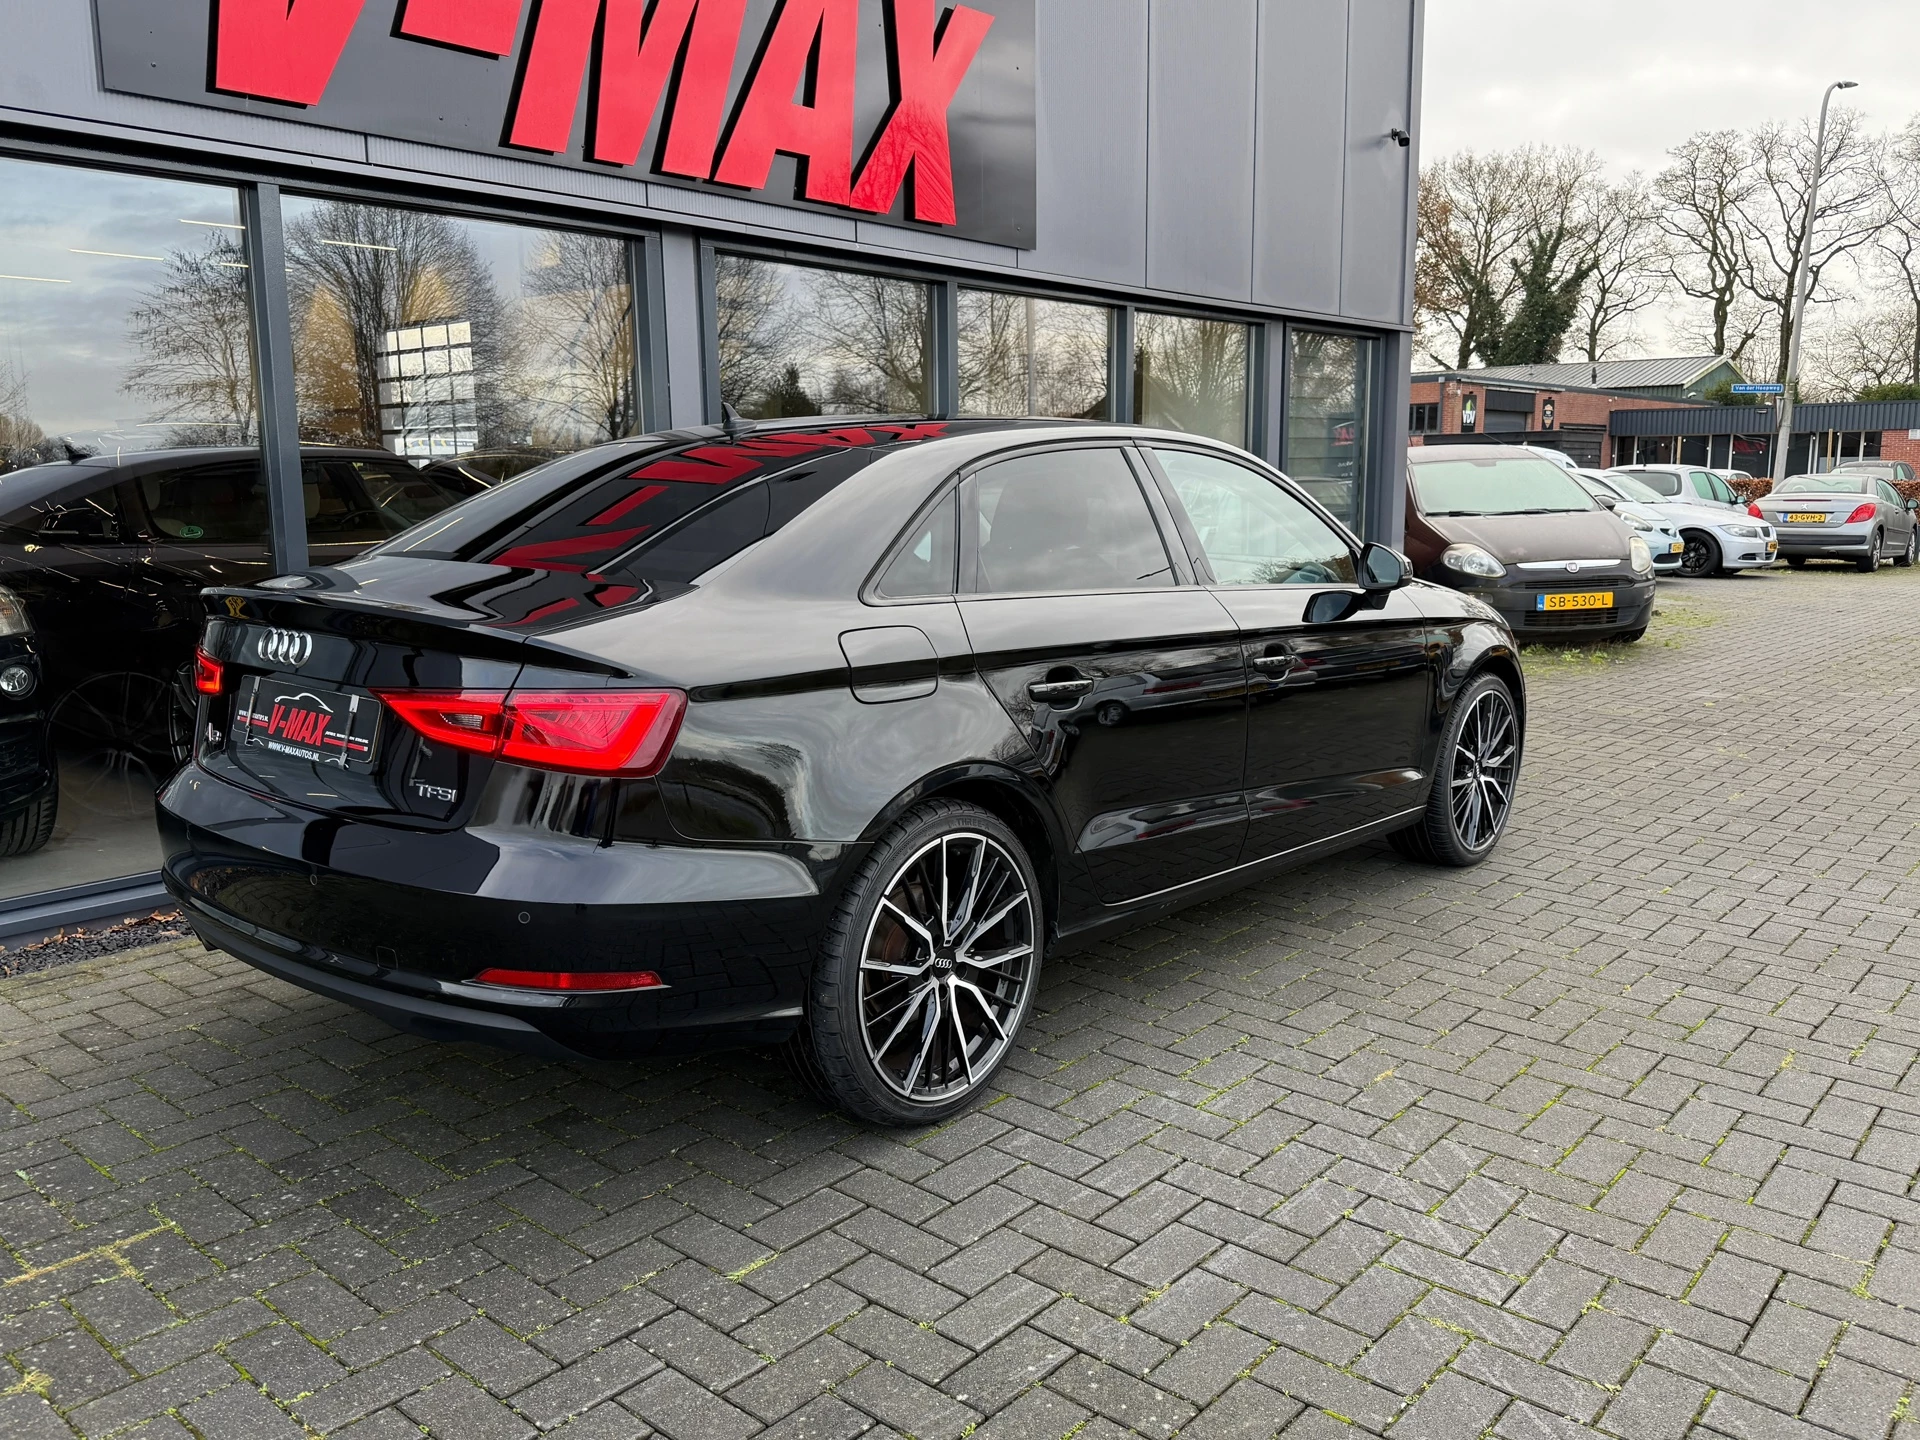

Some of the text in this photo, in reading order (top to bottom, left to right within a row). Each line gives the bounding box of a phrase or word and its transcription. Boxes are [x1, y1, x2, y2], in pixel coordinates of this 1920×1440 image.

[1549, 594, 1608, 608] SB-530-L
[267, 703, 331, 746] V-MAX
[415, 783, 457, 803] TFSI
